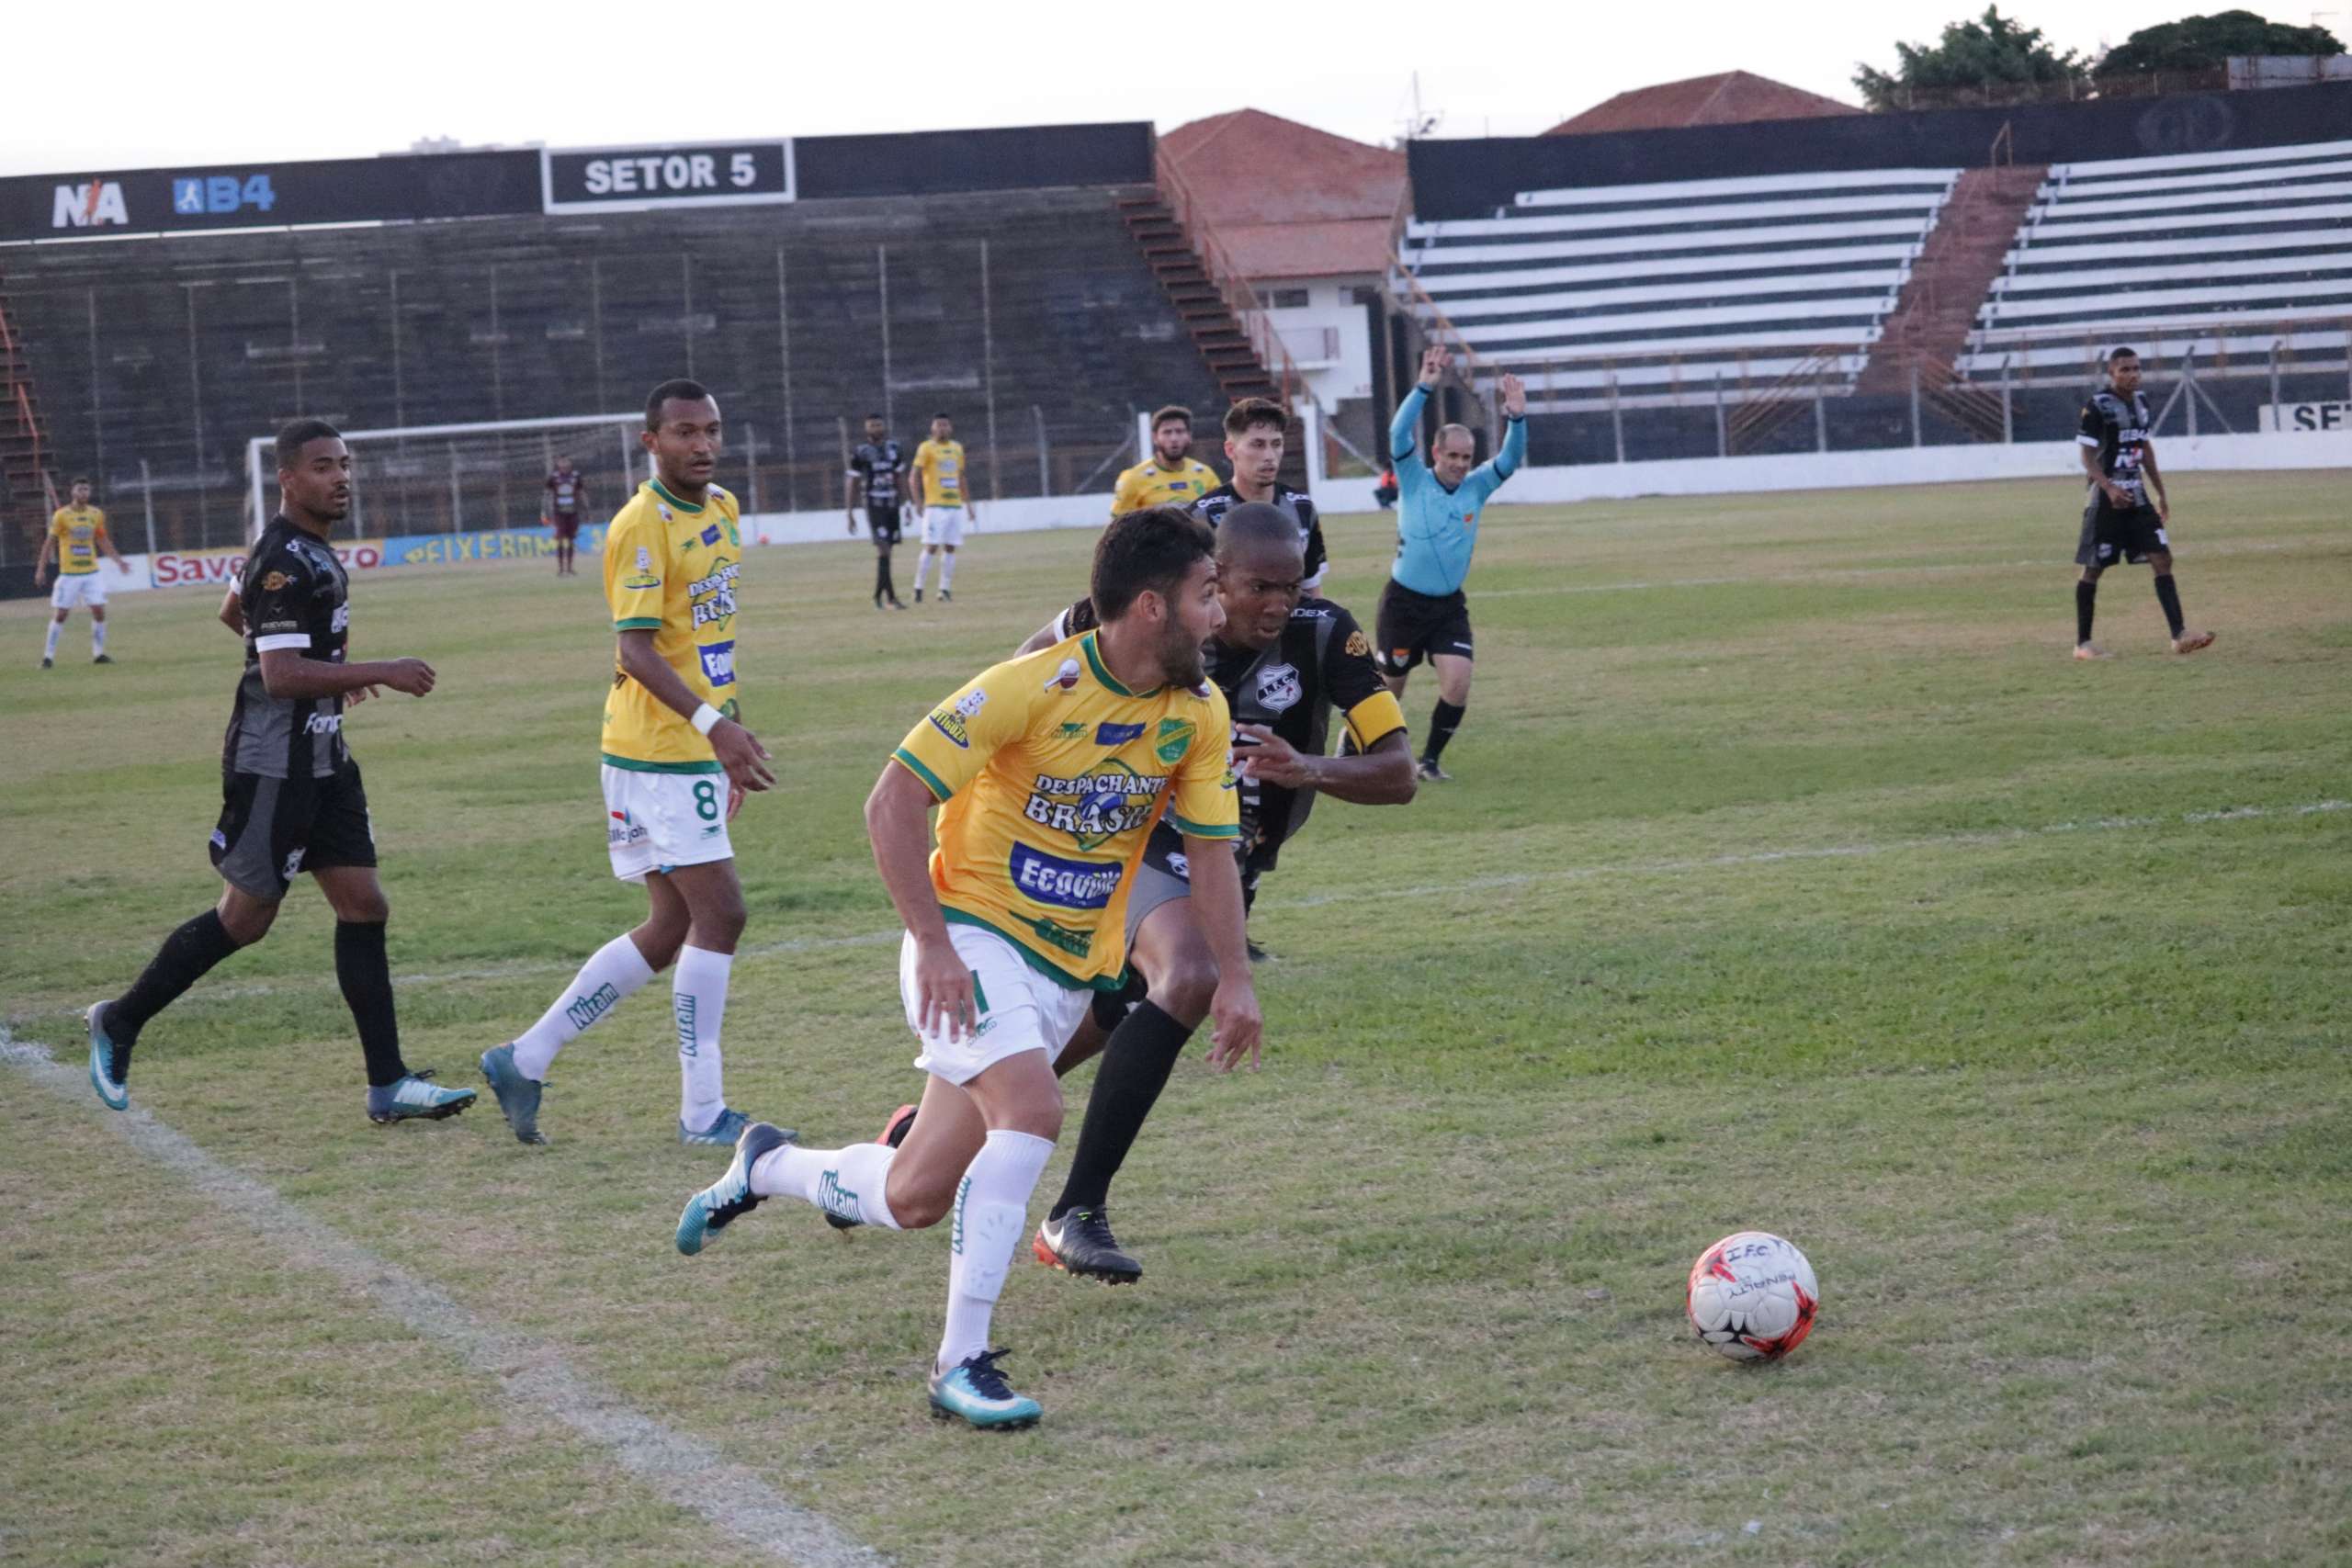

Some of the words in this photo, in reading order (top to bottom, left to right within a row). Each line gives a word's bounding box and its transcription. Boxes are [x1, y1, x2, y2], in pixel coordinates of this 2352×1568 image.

[584, 154, 718, 194] SETOR
[730, 152, 756, 186] 5
[2293, 403, 2352, 432] SE
[693, 780, 718, 821] 8
[566, 982, 620, 1031] Nizam
